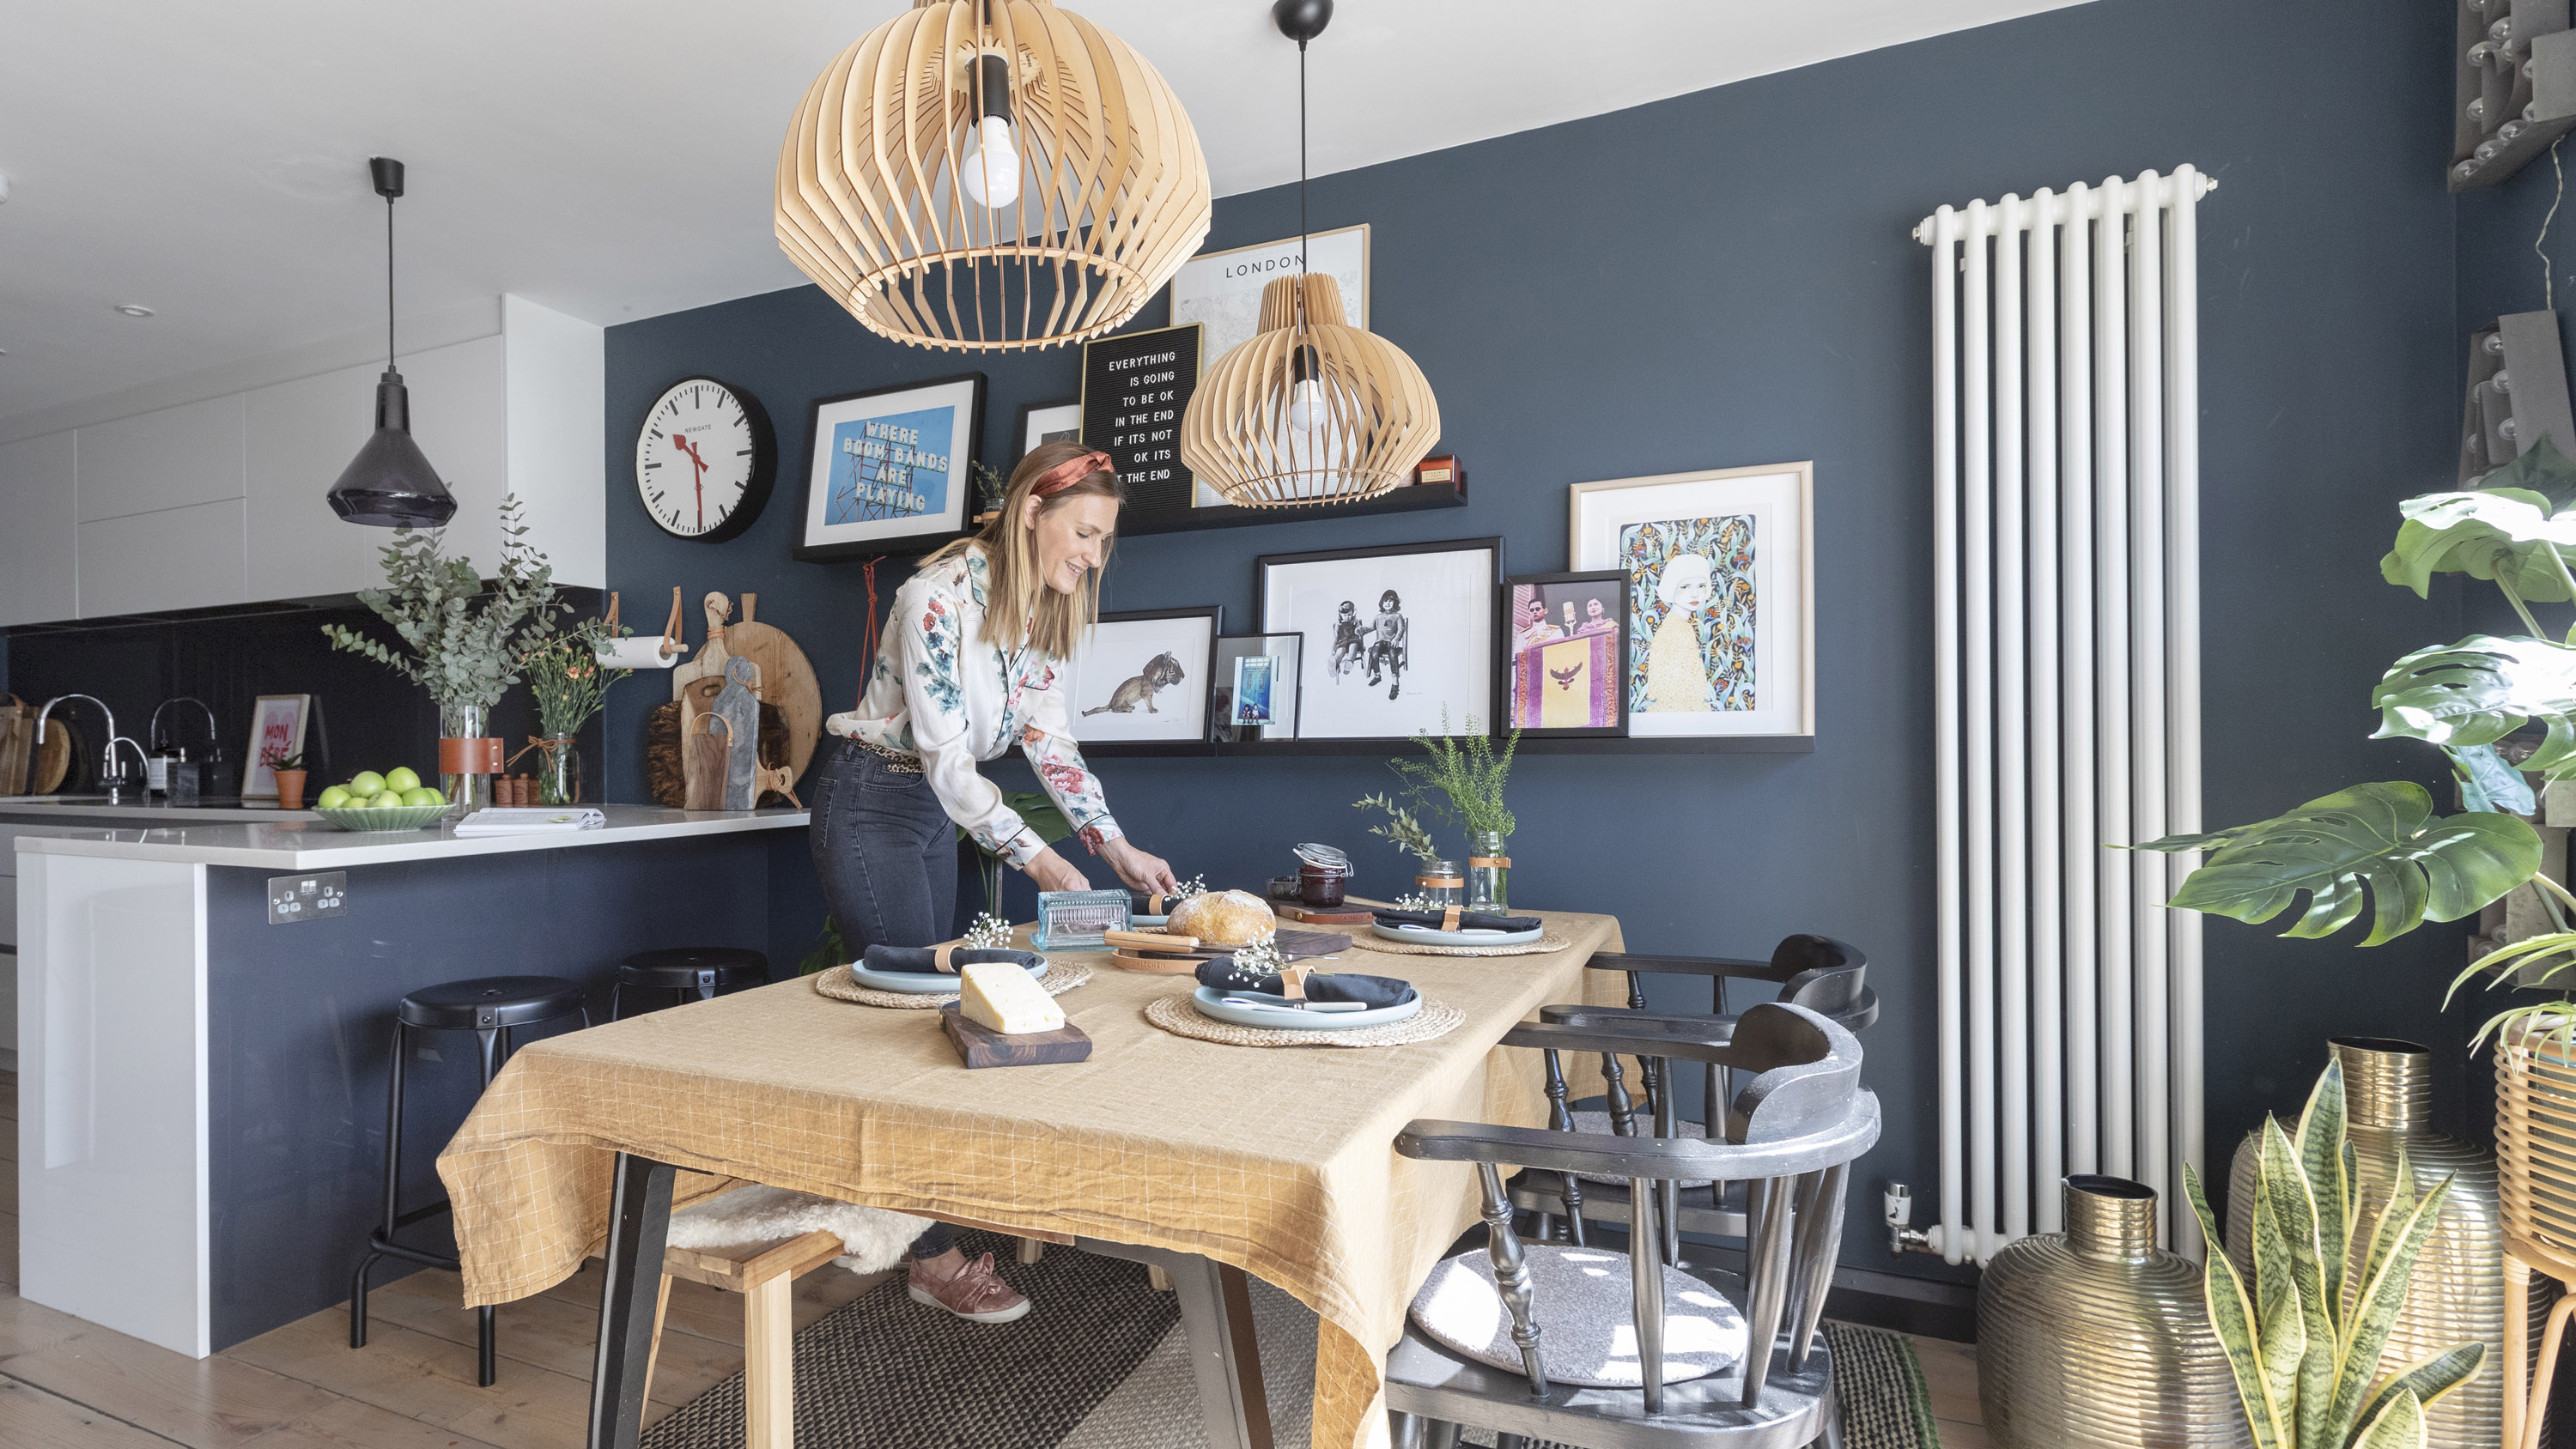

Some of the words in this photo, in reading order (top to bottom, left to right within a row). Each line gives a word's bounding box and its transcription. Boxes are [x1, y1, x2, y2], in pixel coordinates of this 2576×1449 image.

[1225, 254, 1304, 278] LONDON
[1109, 351, 1176, 371] EVERYTHING
[1130, 376, 1139, 387] IS
[1143, 371, 1175, 385] GOING
[1122, 396, 1136, 407] TO
[1141, 393, 1155, 404] BE
[1159, 390, 1174, 401] OK
[1115, 416, 1125, 427] IN
[1130, 413, 1148, 425] THE
[1153, 409, 1174, 421] END
[684, 424, 712, 433] NEWGATE
[866, 421, 919, 446] WHERE
[1114, 435, 1124, 446] IF
[1129, 433, 1145, 445] ITS
[1151, 429, 1172, 441] NOT
[843, 437, 886, 460] BOOM
[894, 447, 948, 473] BANDS
[1133, 452, 1148, 463] OK
[1154, 449, 1171, 461] ITS
[877, 465, 908, 485] ARE
[1127, 471, 1146, 483] THE
[1150, 469, 1170, 481] END
[855, 482, 926, 511] PLAYING
[264, 724, 289, 743] MON
[1136, 961, 1165, 969] KITCHEN
